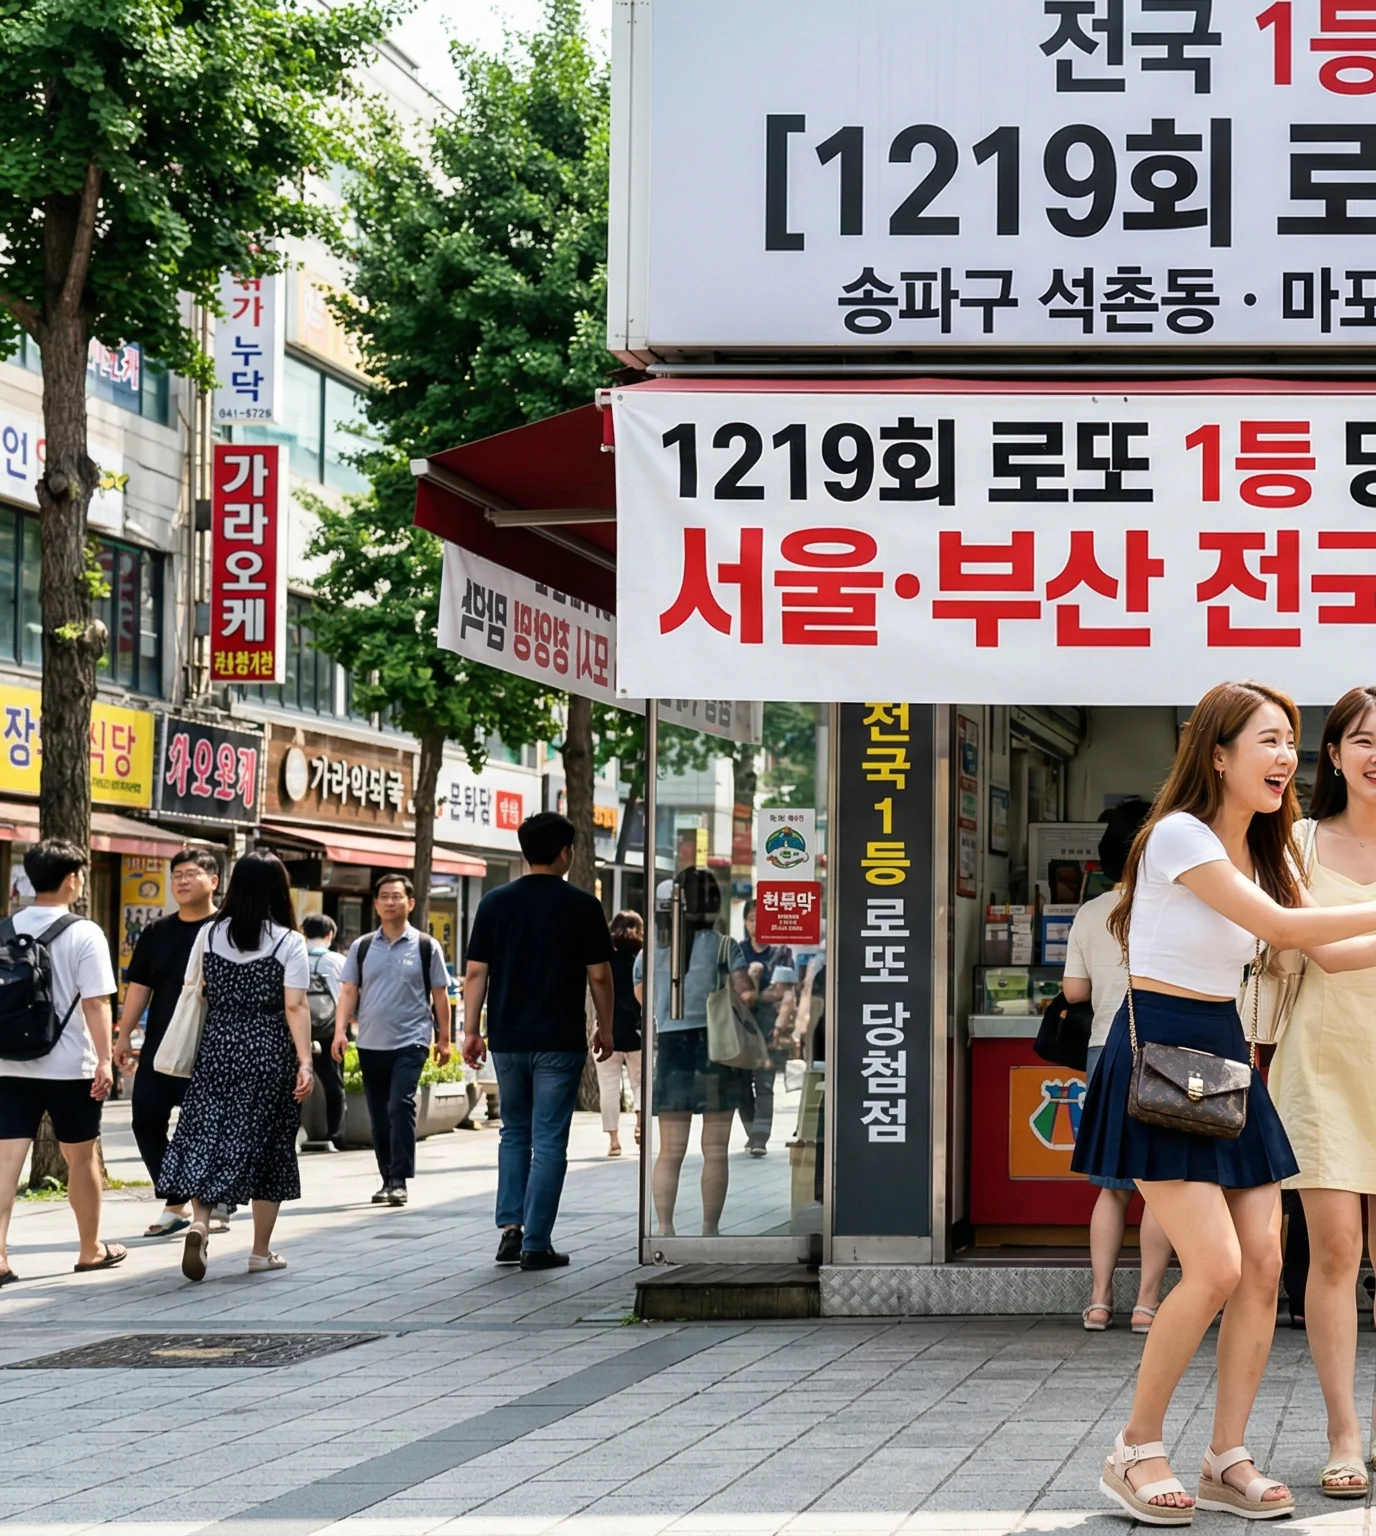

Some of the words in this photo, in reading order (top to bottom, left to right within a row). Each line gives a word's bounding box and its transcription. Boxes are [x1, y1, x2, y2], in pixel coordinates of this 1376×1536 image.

[1040, 0, 1221, 94] 전국
[765, 114, 1232, 251] [1219회
[837, 266, 1019, 335] 송파구
[1038, 266, 1220, 335] 석촌동
[662, 416, 956, 507] 1219회
[988, 421, 1154, 503] 로또
[1185, 420, 1317, 509] 1등
[221, 453, 269, 642] 가라오케
[659, 527, 1165, 648] 서울·부산
[860, 1002, 911, 1143] 당첨점
